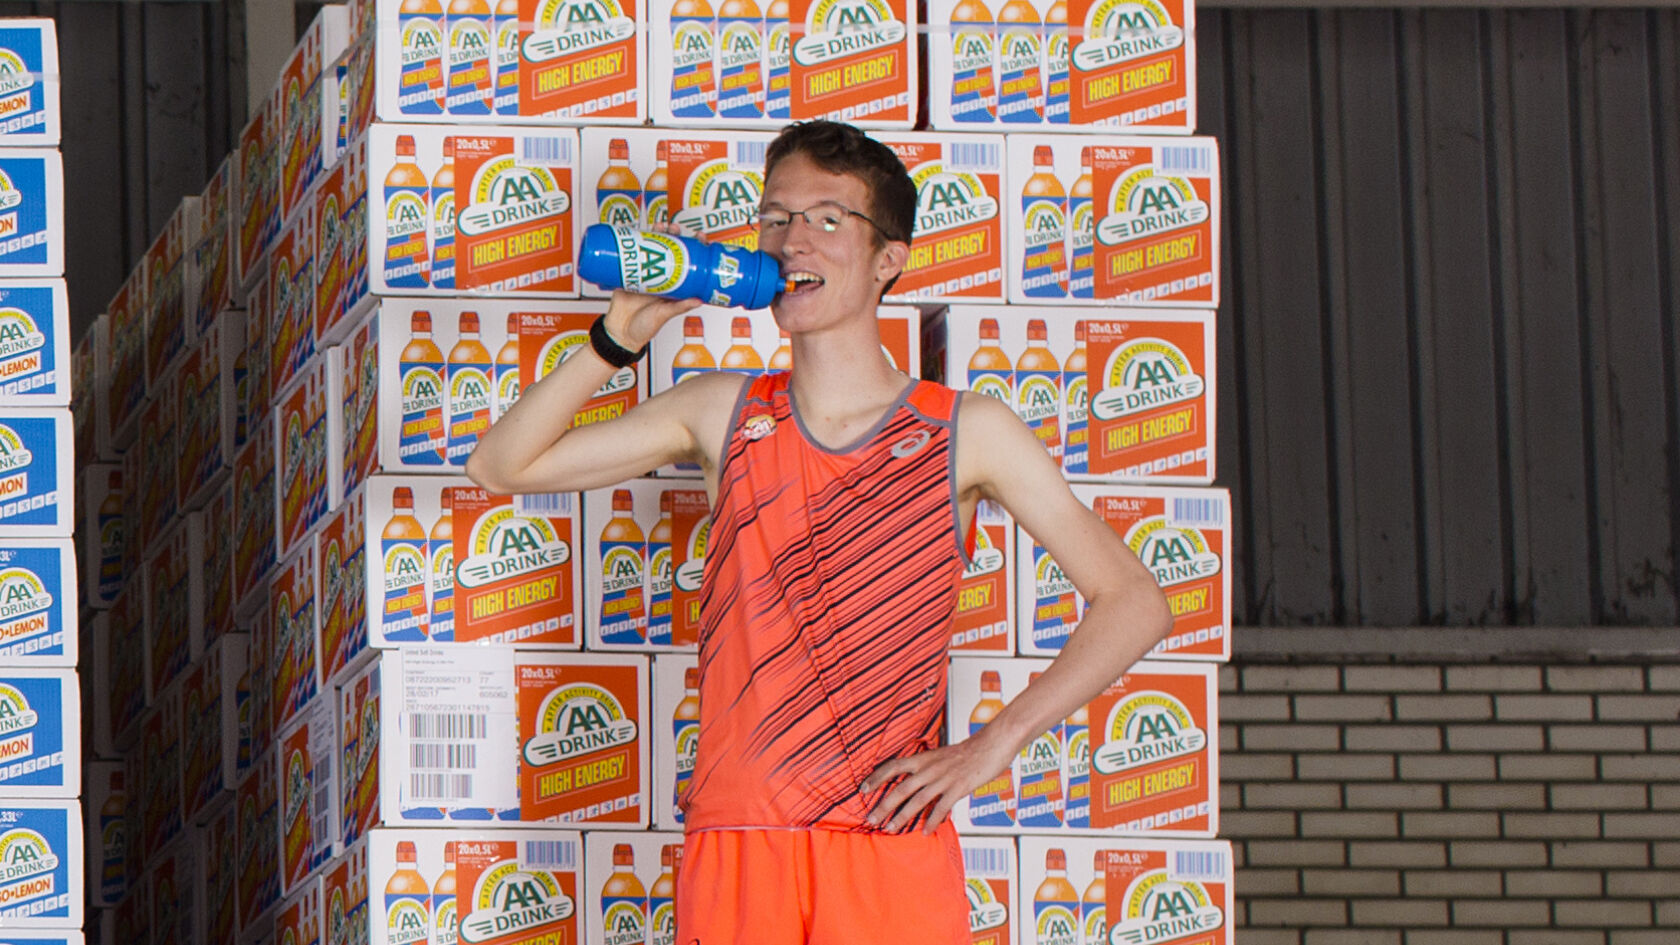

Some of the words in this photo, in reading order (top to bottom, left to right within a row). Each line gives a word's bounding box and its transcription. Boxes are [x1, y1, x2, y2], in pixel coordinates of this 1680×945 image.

[564, 3, 605, 32] AA
[835, 6, 876, 36] AA
[1114, 11, 1154, 41] AA
[557, 26, 615, 51] DRINK
[827, 30, 886, 54] DRINK
[1106, 34, 1164, 60] DRINK
[538, 68, 570, 94] HIGH
[572, 51, 624, 84] ENERGY
[810, 73, 841, 98] HIGH
[844, 55, 894, 83] ENERGY
[1088, 78, 1120, 103] HIGH
[1123, 60, 1172, 92] ENERGY
[500, 175, 541, 206] AA
[713, 180, 754, 209] AA
[928, 181, 969, 212] AA
[1139, 186, 1179, 215] AA
[492, 199, 550, 225] DRINK
[705, 205, 760, 229] DRINK
[920, 205, 978, 231] DRINK
[1131, 208, 1189, 234] DRINK
[473, 240, 505, 266] HIGH
[507, 225, 557, 257] ENERGY
[935, 230, 986, 265] ENERGY
[1112, 252, 1144, 276] HIGH
[1146, 235, 1197, 268] ENERGY
[621, 238, 639, 291] DRINK
[639, 245, 666, 284] AA
[1134, 360, 1175, 390] AA
[1125, 384, 1184, 409] DRINK
[1107, 427, 1139, 451] HIGH
[1141, 409, 1192, 442] ENERGY
[500, 526, 541, 557] AA
[1150, 537, 1192, 568] AA
[491, 549, 550, 576] DRINK
[1157, 561, 1201, 582] RINK
[6, 583, 33, 603] AA
[473, 593, 505, 619] HIGH
[507, 576, 558, 611] ENERGY
[957, 584, 992, 612] ERGY
[1, 599, 39, 617] DRINK
[547, 696, 563, 722] AFTER
[566, 704, 609, 736] AA
[559, 728, 618, 755] DRINK
[1135, 713, 1177, 744] AA
[1127, 736, 1186, 763] DRINK
[540, 772, 573, 798] HIGH
[576, 754, 625, 789] ENERGY
[1109, 781, 1140, 805] HIGH
[1144, 763, 1195, 797] ENERGY
[6, 860, 46, 878] DRINK
[11, 844, 38, 865] AA
[484, 873, 499, 899] AFTER
[502, 881, 545, 912] AA
[495, 904, 554, 931] DRINK
[1152, 891, 1193, 921] AA
[1144, 915, 1203, 941] DRINK
